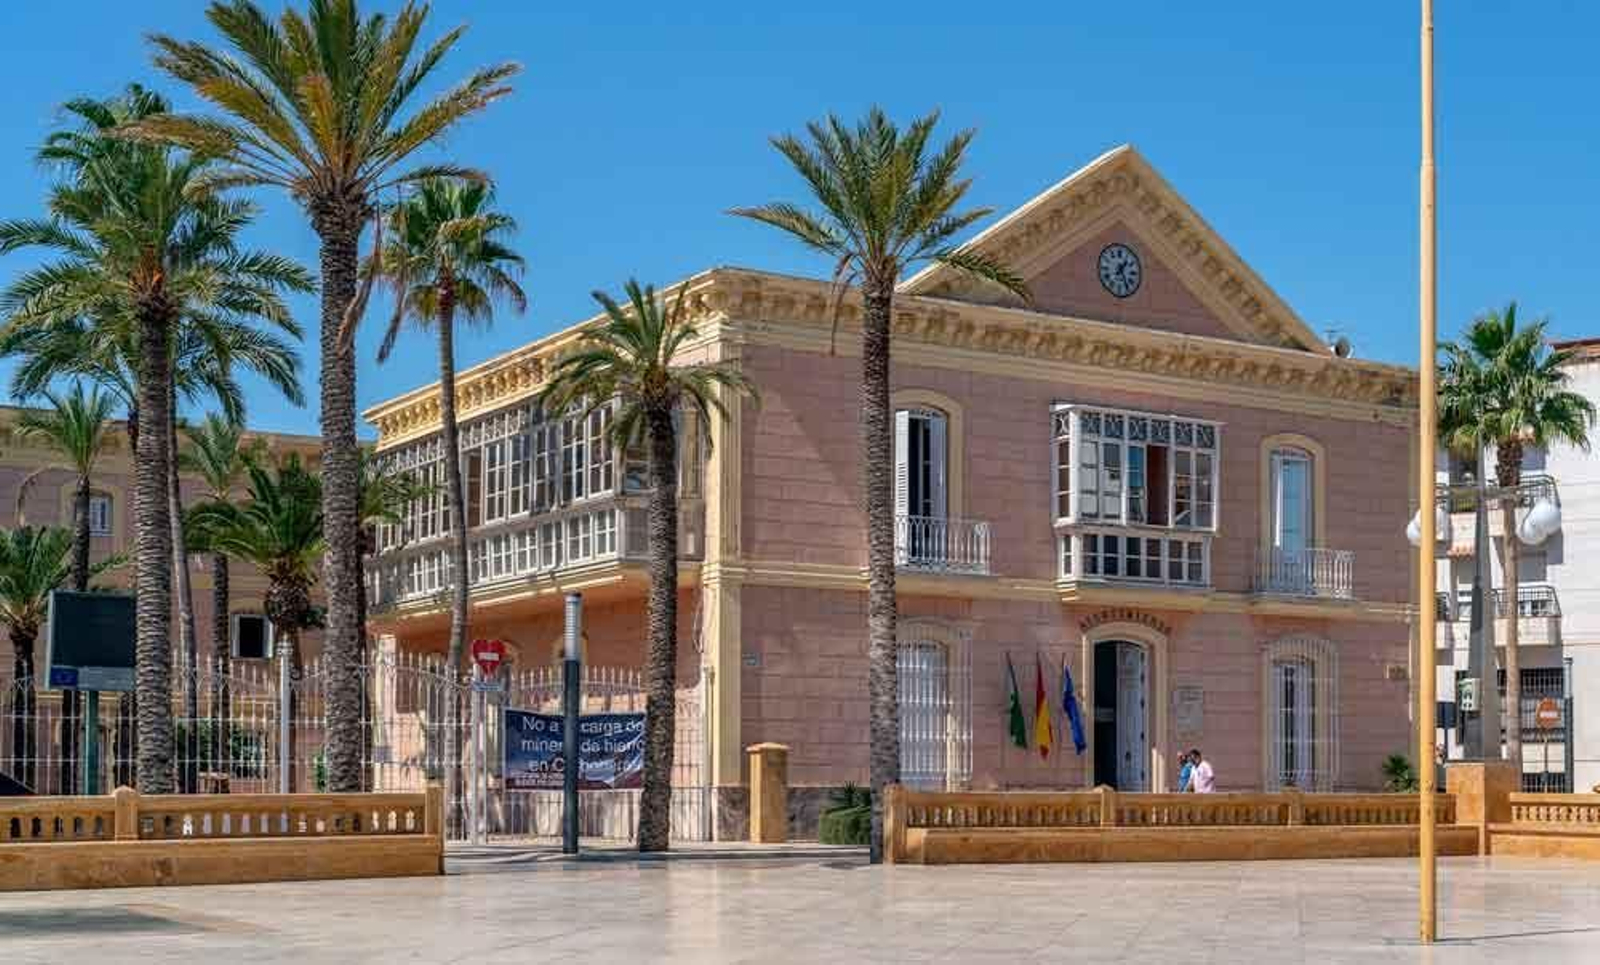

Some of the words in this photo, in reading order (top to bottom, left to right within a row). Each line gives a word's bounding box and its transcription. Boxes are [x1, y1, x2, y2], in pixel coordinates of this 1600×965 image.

[523, 716, 545, 732] No
[549, 721, 559, 732] a
[581, 721, 623, 736] carga
[521, 739, 564, 752] miner
[581, 739, 600, 752] de
[529, 760, 548, 772] en
